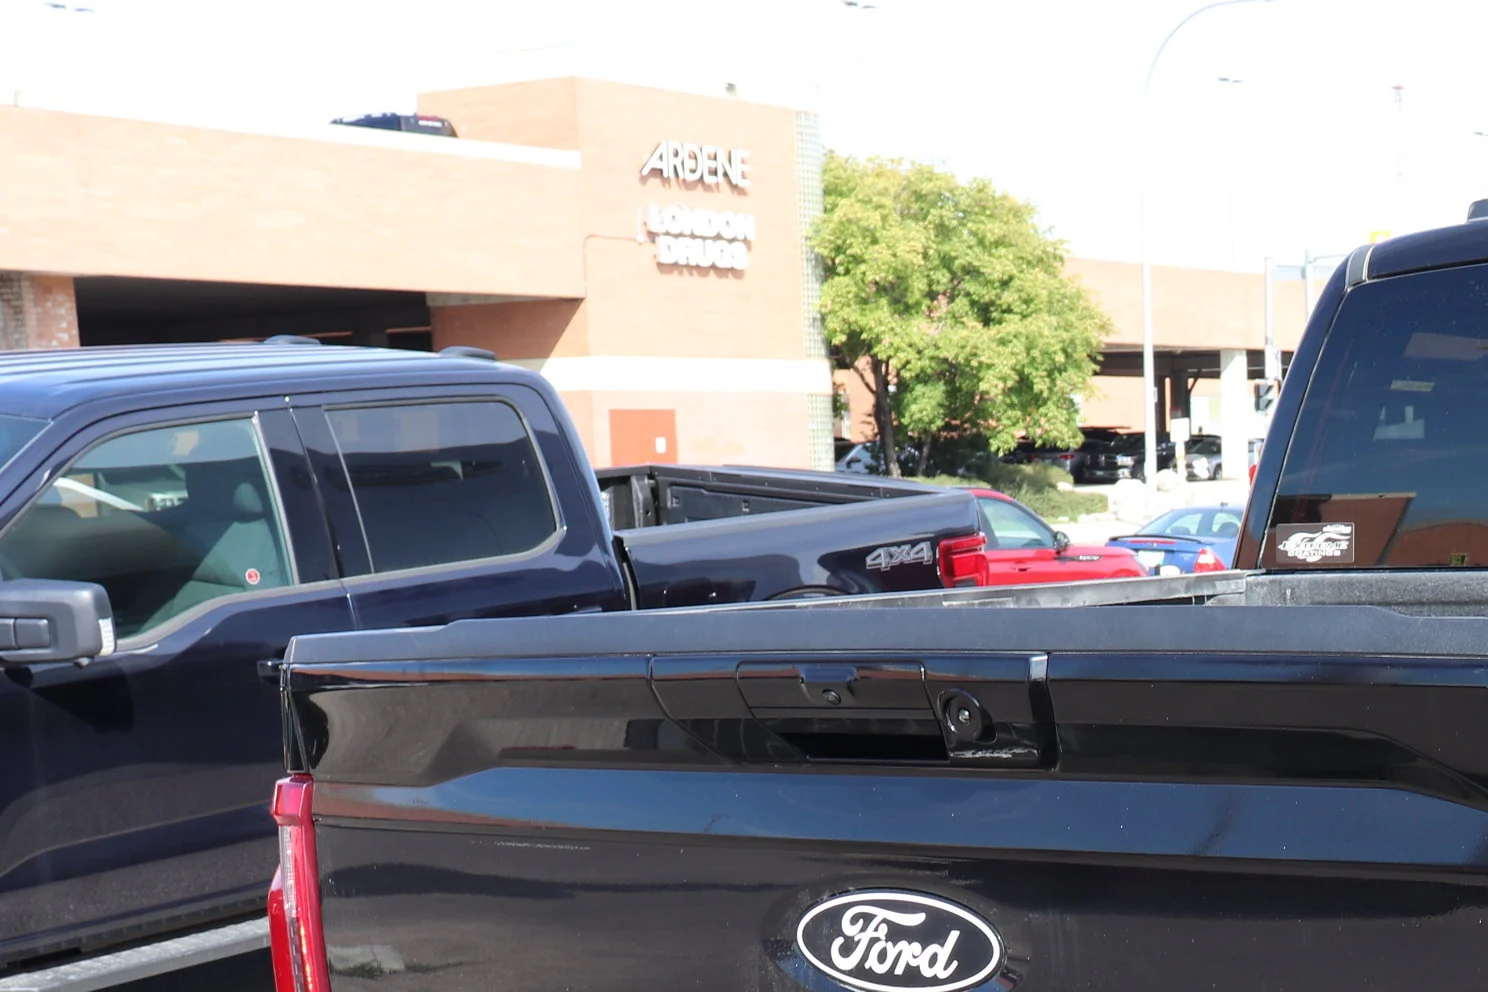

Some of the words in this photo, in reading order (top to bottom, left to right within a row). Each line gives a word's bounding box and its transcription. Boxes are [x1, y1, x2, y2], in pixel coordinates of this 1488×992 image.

[640, 140, 753, 188] ARDENE
[647, 203, 757, 242] LONDON
[655, 235, 750, 271] DRUGS
[830, 904, 961, 980] Ford
